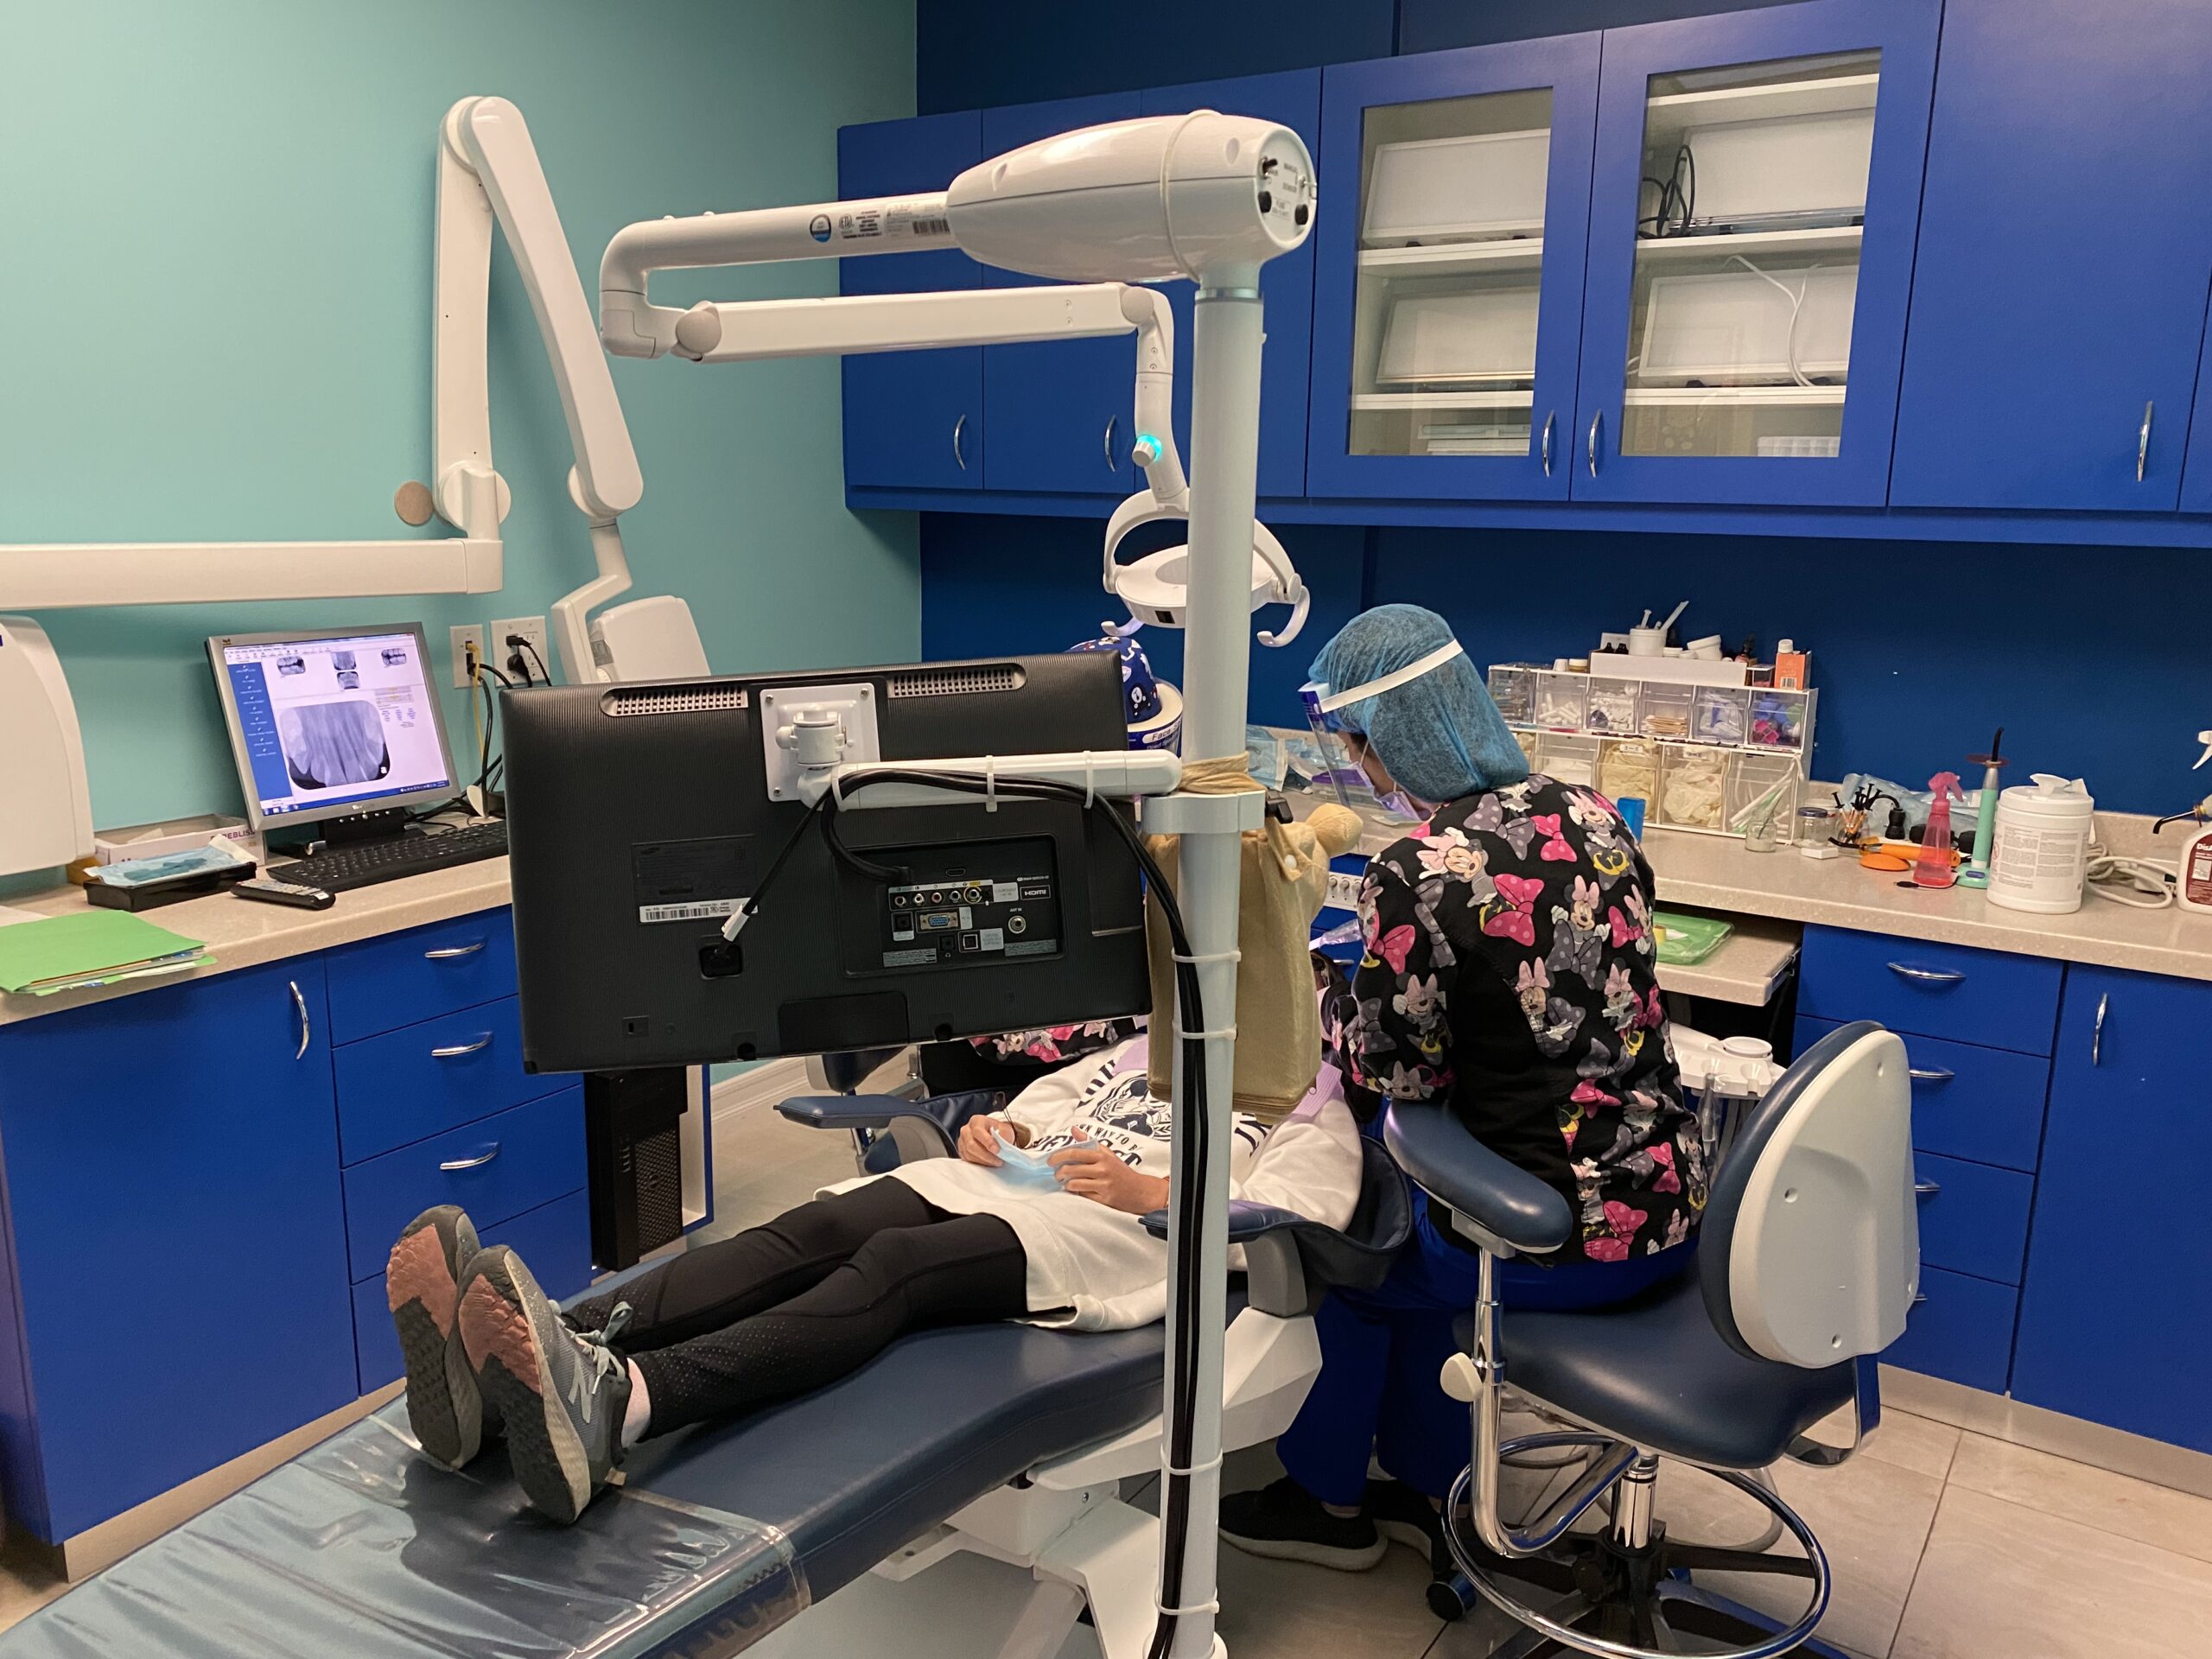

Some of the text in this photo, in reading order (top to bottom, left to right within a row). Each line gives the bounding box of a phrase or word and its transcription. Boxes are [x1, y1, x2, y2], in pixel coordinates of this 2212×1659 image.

[1152, 728, 1171, 741] Face
[210, 830, 256, 839] EBLISS
[1094, 1127, 1116, 1138] WAY
[1115, 1133, 1129, 1145] TO
